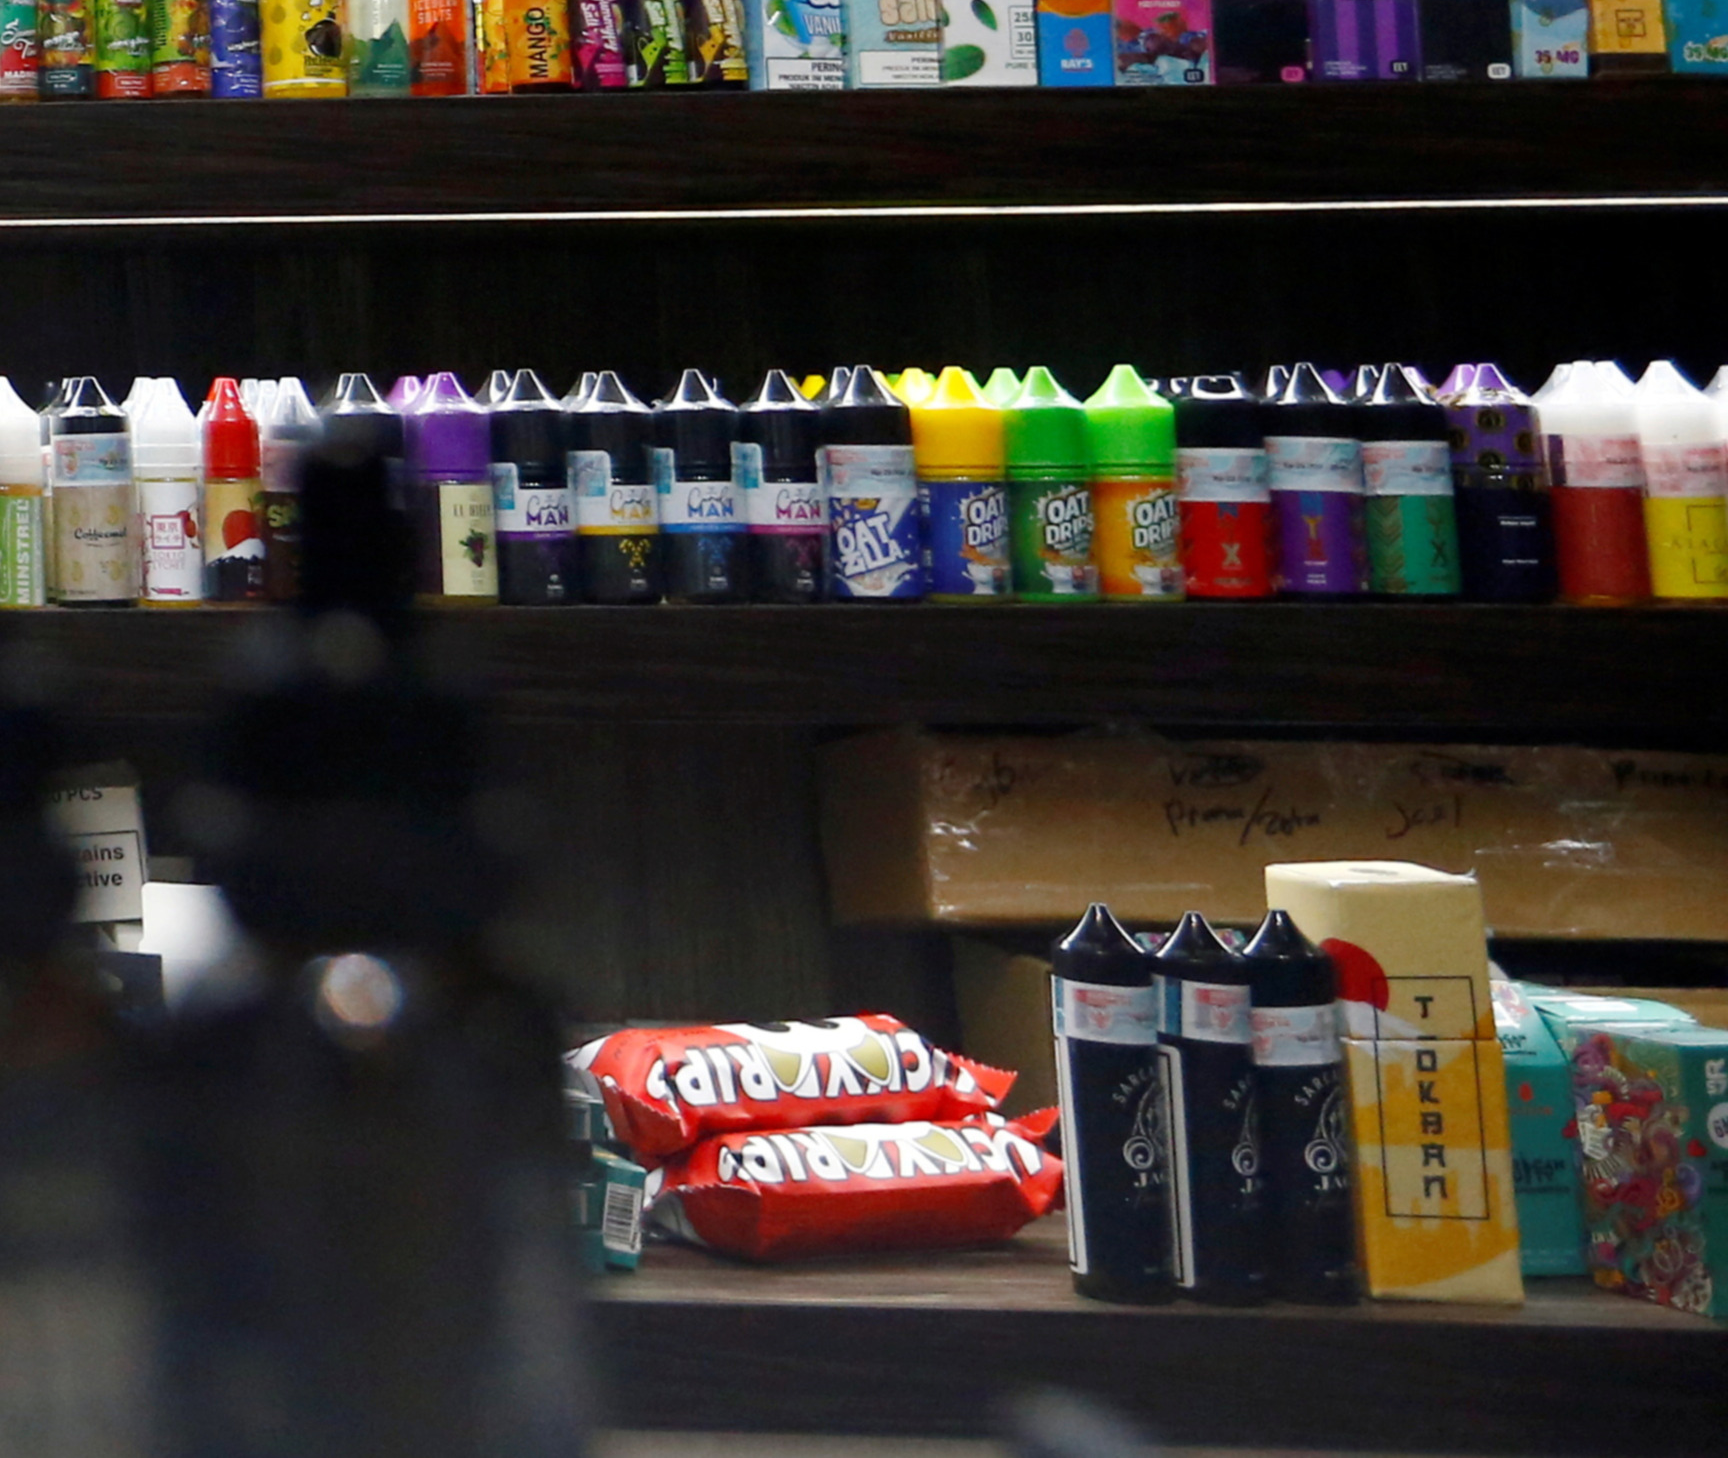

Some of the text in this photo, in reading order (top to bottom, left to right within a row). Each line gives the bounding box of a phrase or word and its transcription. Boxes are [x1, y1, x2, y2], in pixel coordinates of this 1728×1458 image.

[528, 6, 547, 81] MANGO
[527, 510, 569, 527] MAN
[610, 504, 653, 520] MAN
[687, 504, 734, 519] MAN
[776, 506, 822, 520] MAN
[968, 493, 1007, 523] OAT
[1047, 491, 1089, 523] OAT
[1135, 495, 1178, 526] OAT
[836, 512, 892, 553] OAT
[16, 498, 30, 606] MINSTREL
